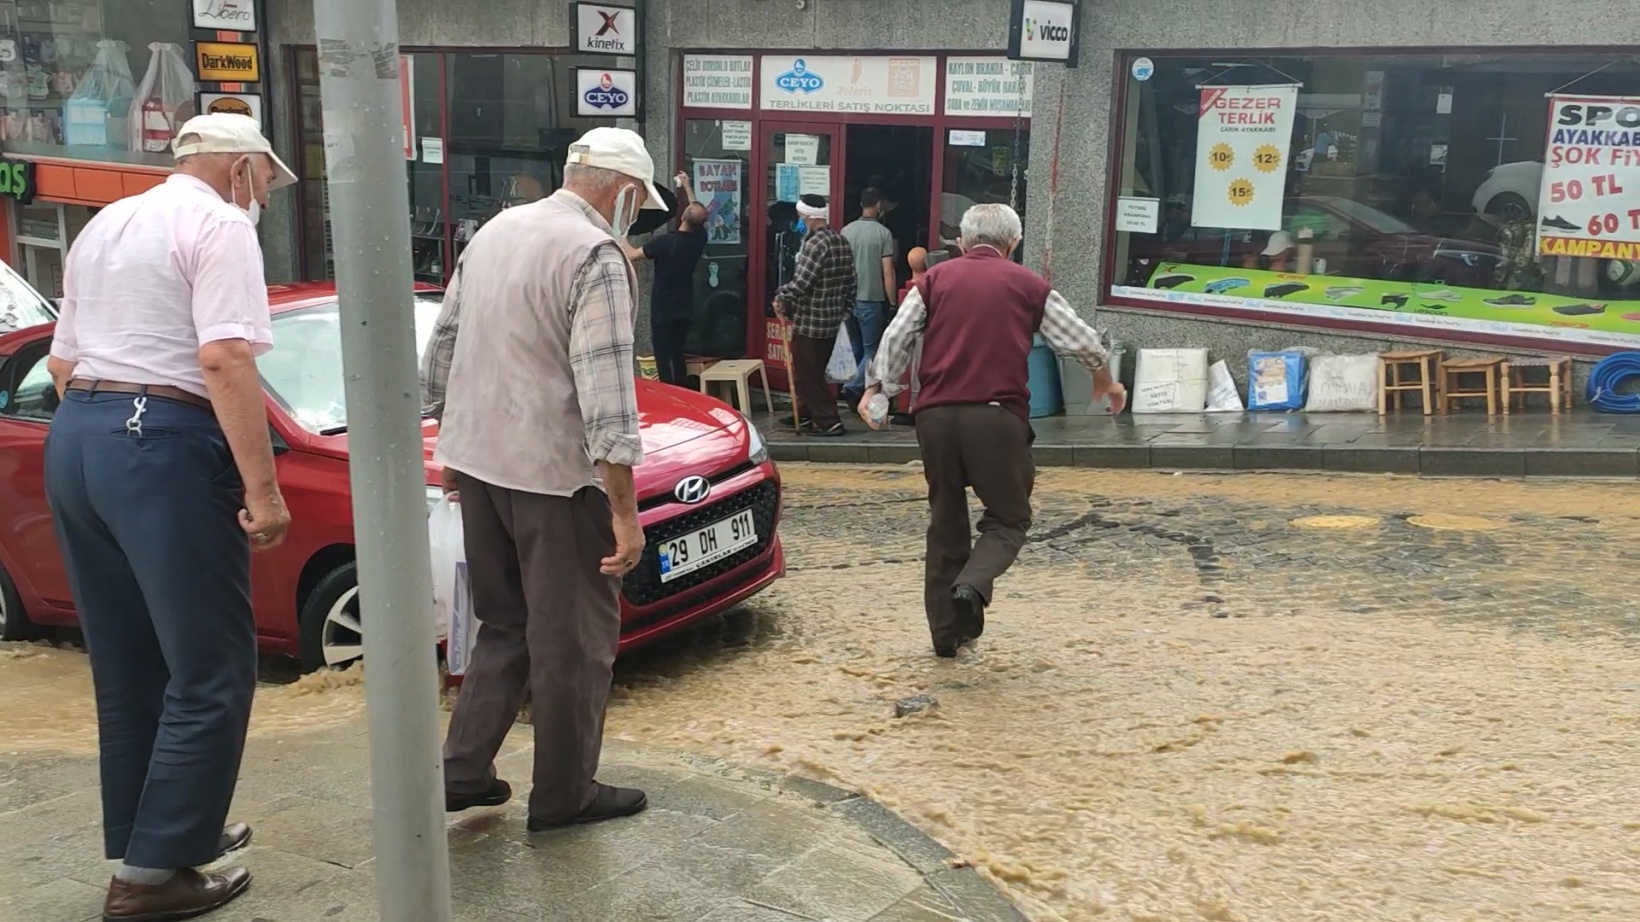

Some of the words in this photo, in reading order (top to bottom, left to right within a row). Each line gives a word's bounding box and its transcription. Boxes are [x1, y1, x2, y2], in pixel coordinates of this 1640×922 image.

[198, 0, 251, 21] Libero
[1040, 19, 1068, 41] vicco
[587, 36, 625, 51] kinetix
[202, 53, 253, 70] DarkWood
[779, 78, 821, 88] CEYO
[585, 92, 627, 104] CEYO
[769, 98, 834, 110] TERLİKLERİ
[838, 102, 871, 113] SATIŞ
[874, 102, 930, 113] NOKTASI
[1214, 97, 1281, 110] GEZER
[1218, 110, 1276, 125] TERLİK
[1551, 146, 1602, 168] ŞOK
[699, 164, 737, 177] BAYAN
[1551, 179, 1584, 203] 50
[1591, 174, 1623, 197] TL
[1587, 212, 1619, 236] 60
[669, 539, 688, 567] 29
[698, 527, 718, 555] DH
[731, 513, 750, 541] 911
